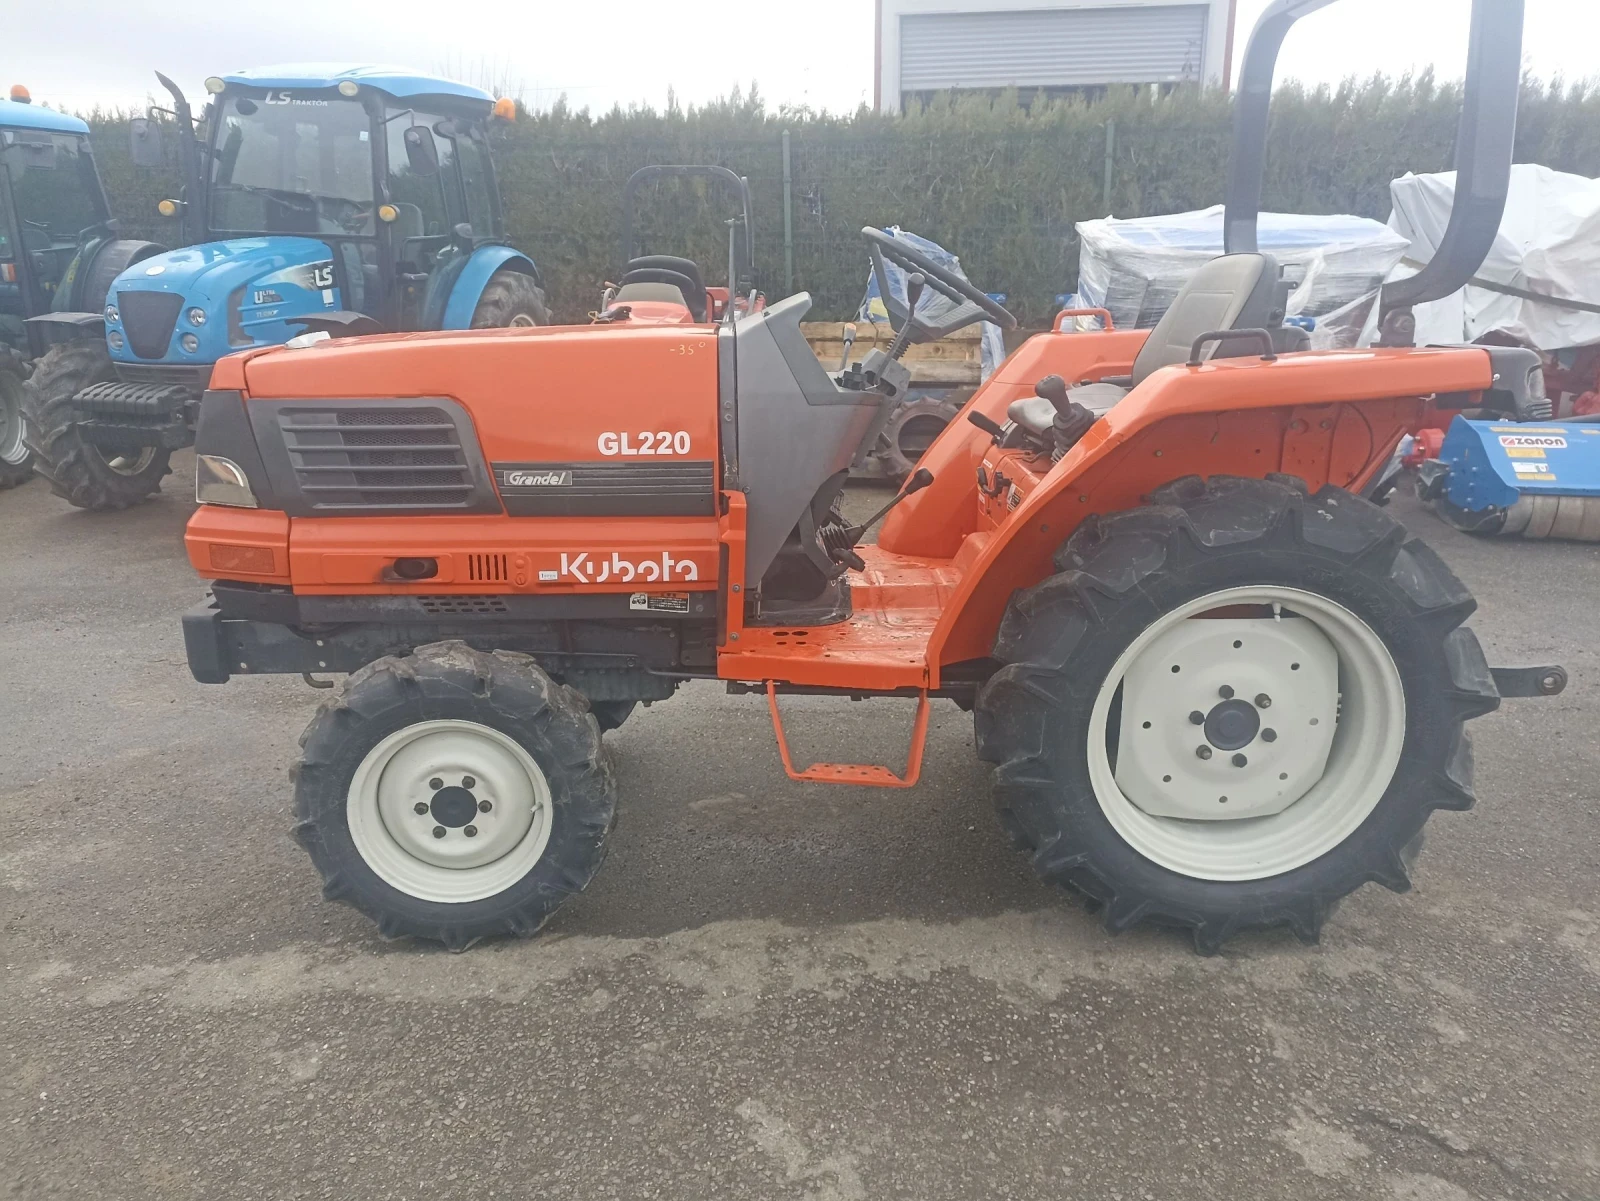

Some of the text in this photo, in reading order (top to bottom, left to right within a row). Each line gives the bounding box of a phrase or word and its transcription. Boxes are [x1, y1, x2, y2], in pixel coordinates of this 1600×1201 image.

[265, 91, 292, 105] LS
[314, 265, 334, 287] LS
[597, 430, 691, 456] GL220
[509, 471, 566, 486] Grandel
[560, 551, 698, 583] Kubota
